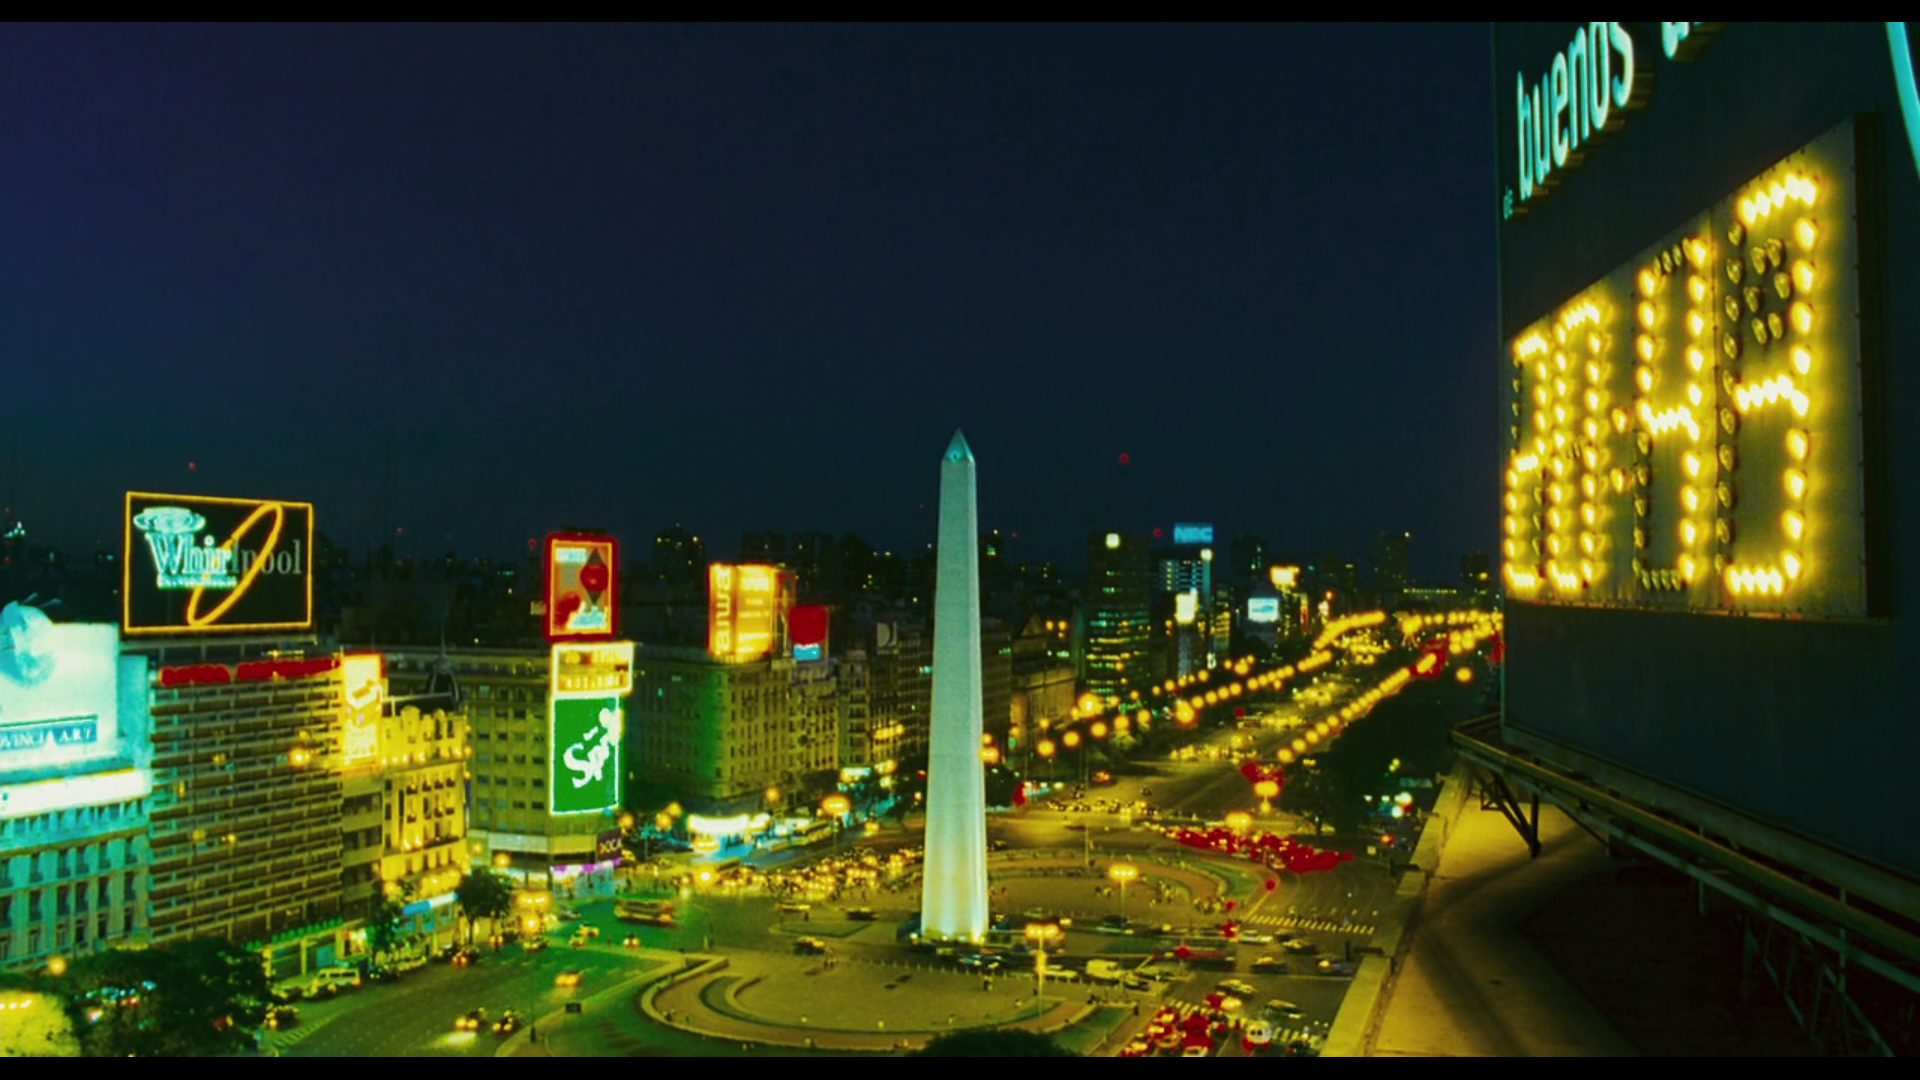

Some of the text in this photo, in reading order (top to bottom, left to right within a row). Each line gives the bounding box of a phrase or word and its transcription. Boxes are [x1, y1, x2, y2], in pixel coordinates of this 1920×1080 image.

[1518, 22, 1634, 201] buenos
[145, 531, 302, 576] Whirlpool
[715, 567, 732, 653] aiwa
